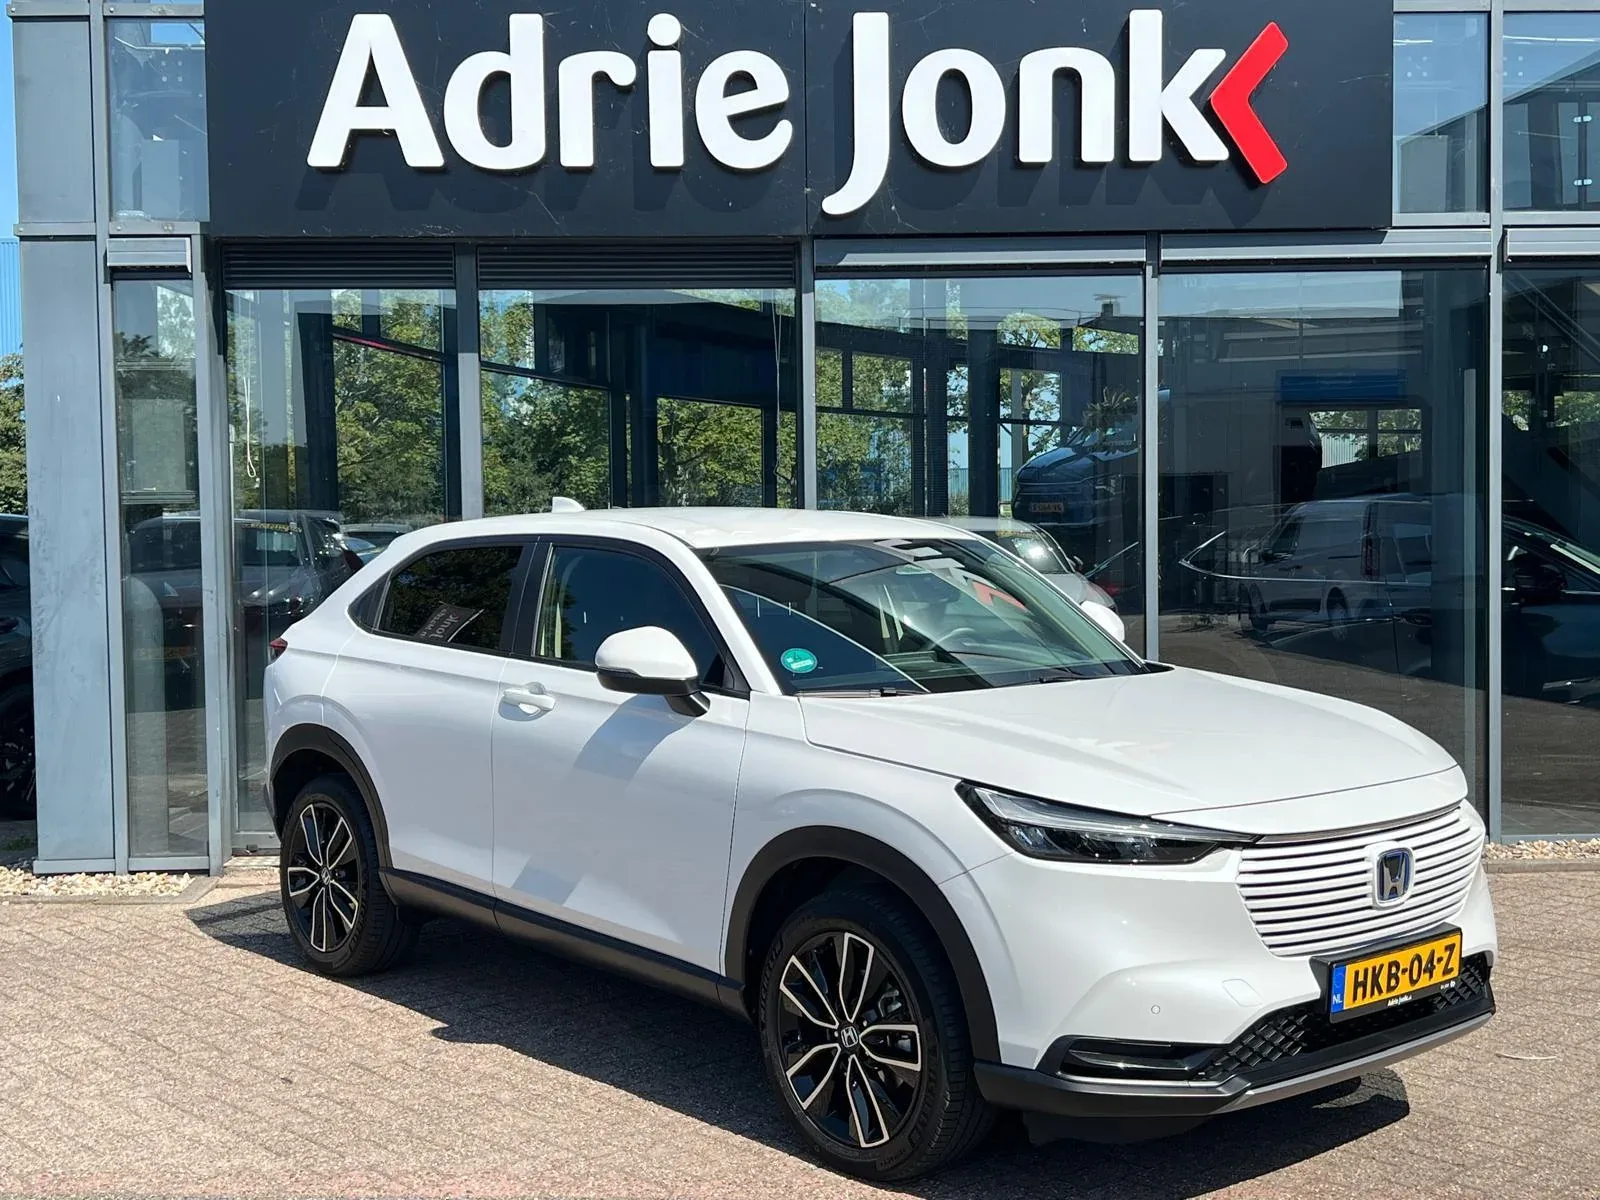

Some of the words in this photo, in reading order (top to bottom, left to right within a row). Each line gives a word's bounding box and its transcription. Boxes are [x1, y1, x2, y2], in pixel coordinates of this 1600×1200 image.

[306, 13, 793, 170] Adrie
[821, 9, 1230, 215] Jonk
[1332, 993, 1343, 1004] NL
[1352, 942, 1457, 1004] HKB-04-Z
